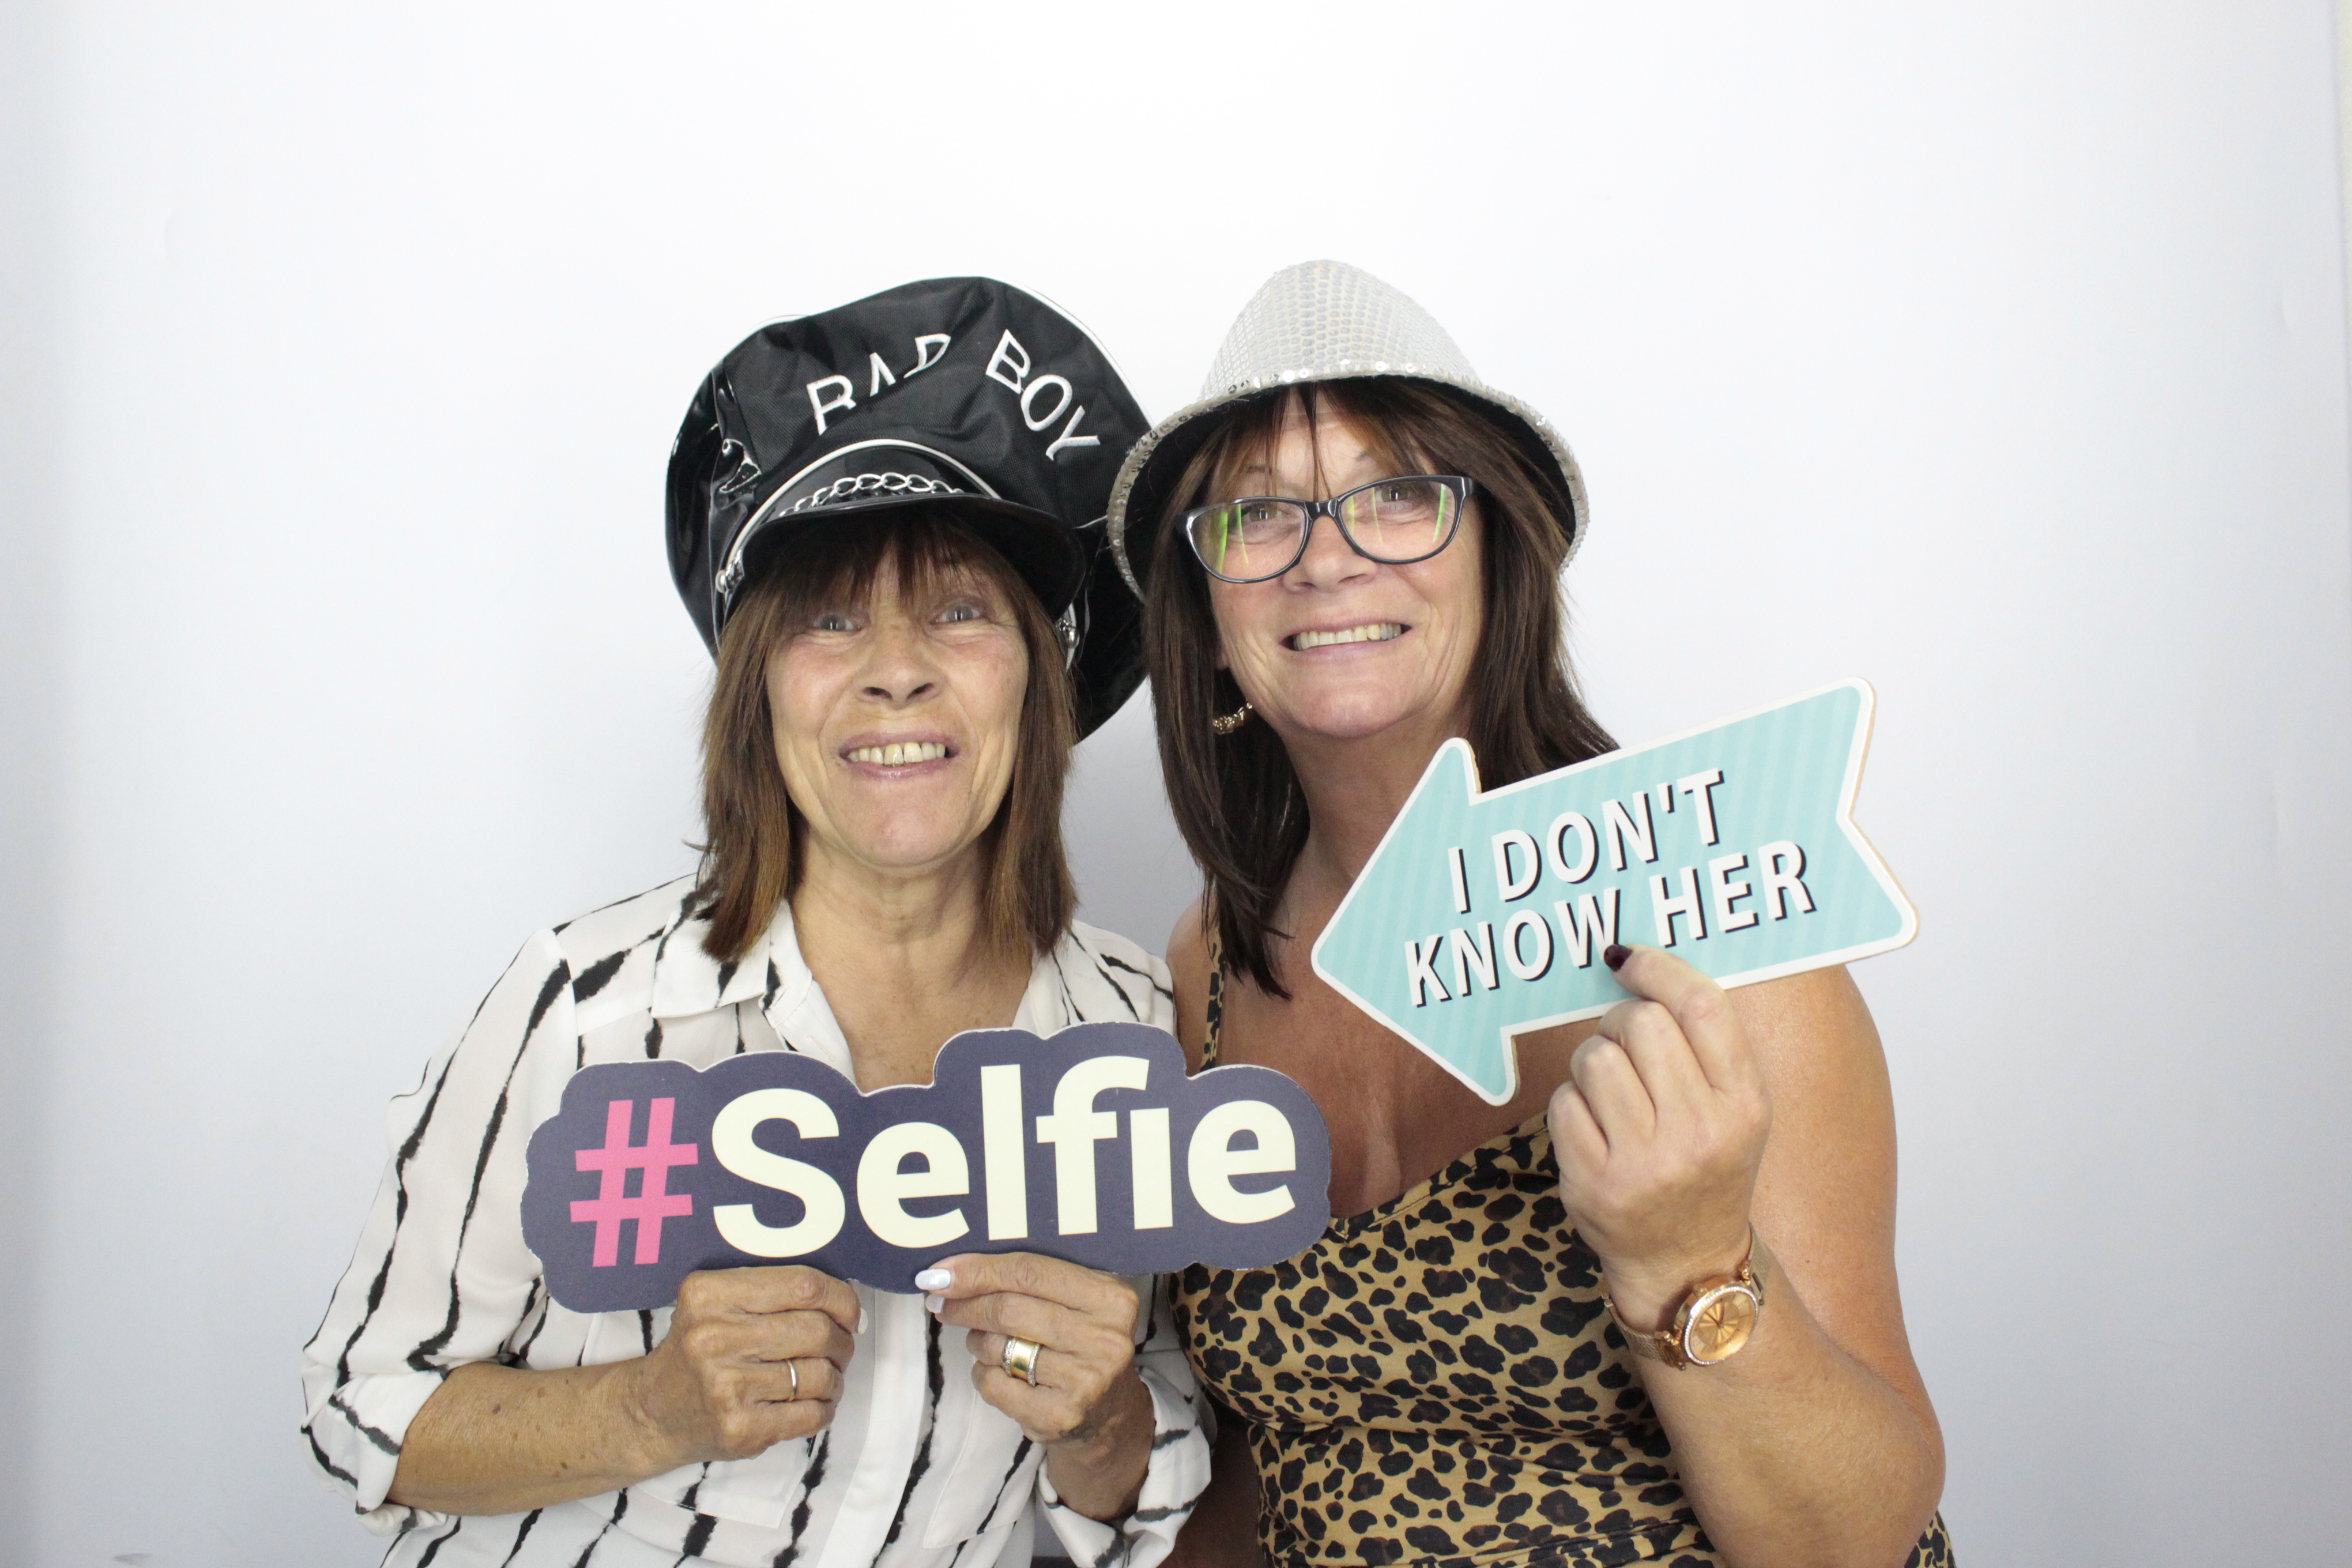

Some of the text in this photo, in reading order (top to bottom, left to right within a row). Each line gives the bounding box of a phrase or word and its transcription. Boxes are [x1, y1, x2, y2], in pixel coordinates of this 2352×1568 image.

[985, 329, 1100, 461] BOY
[1448, 768, 1724, 913] I DON'T
[1404, 840, 1817, 1007] KNOW HER
[570, 1055, 1296, 1267] #Selfie
